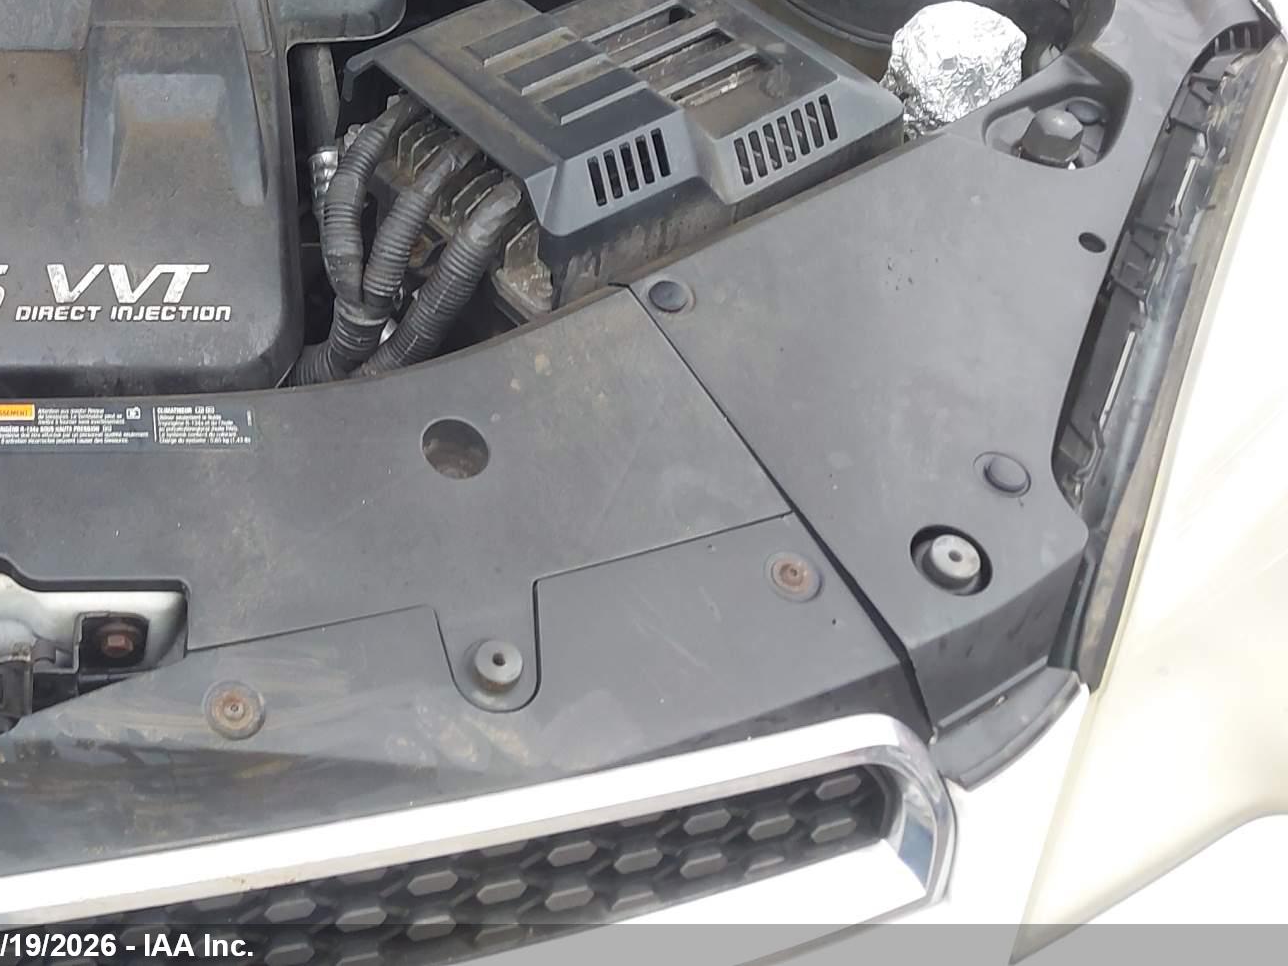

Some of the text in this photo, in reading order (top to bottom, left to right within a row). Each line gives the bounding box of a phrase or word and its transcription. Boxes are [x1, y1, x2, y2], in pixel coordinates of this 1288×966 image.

[47, 263, 211, 304] VVT
[15, 305, 233, 322] DIRECT INJECTION
